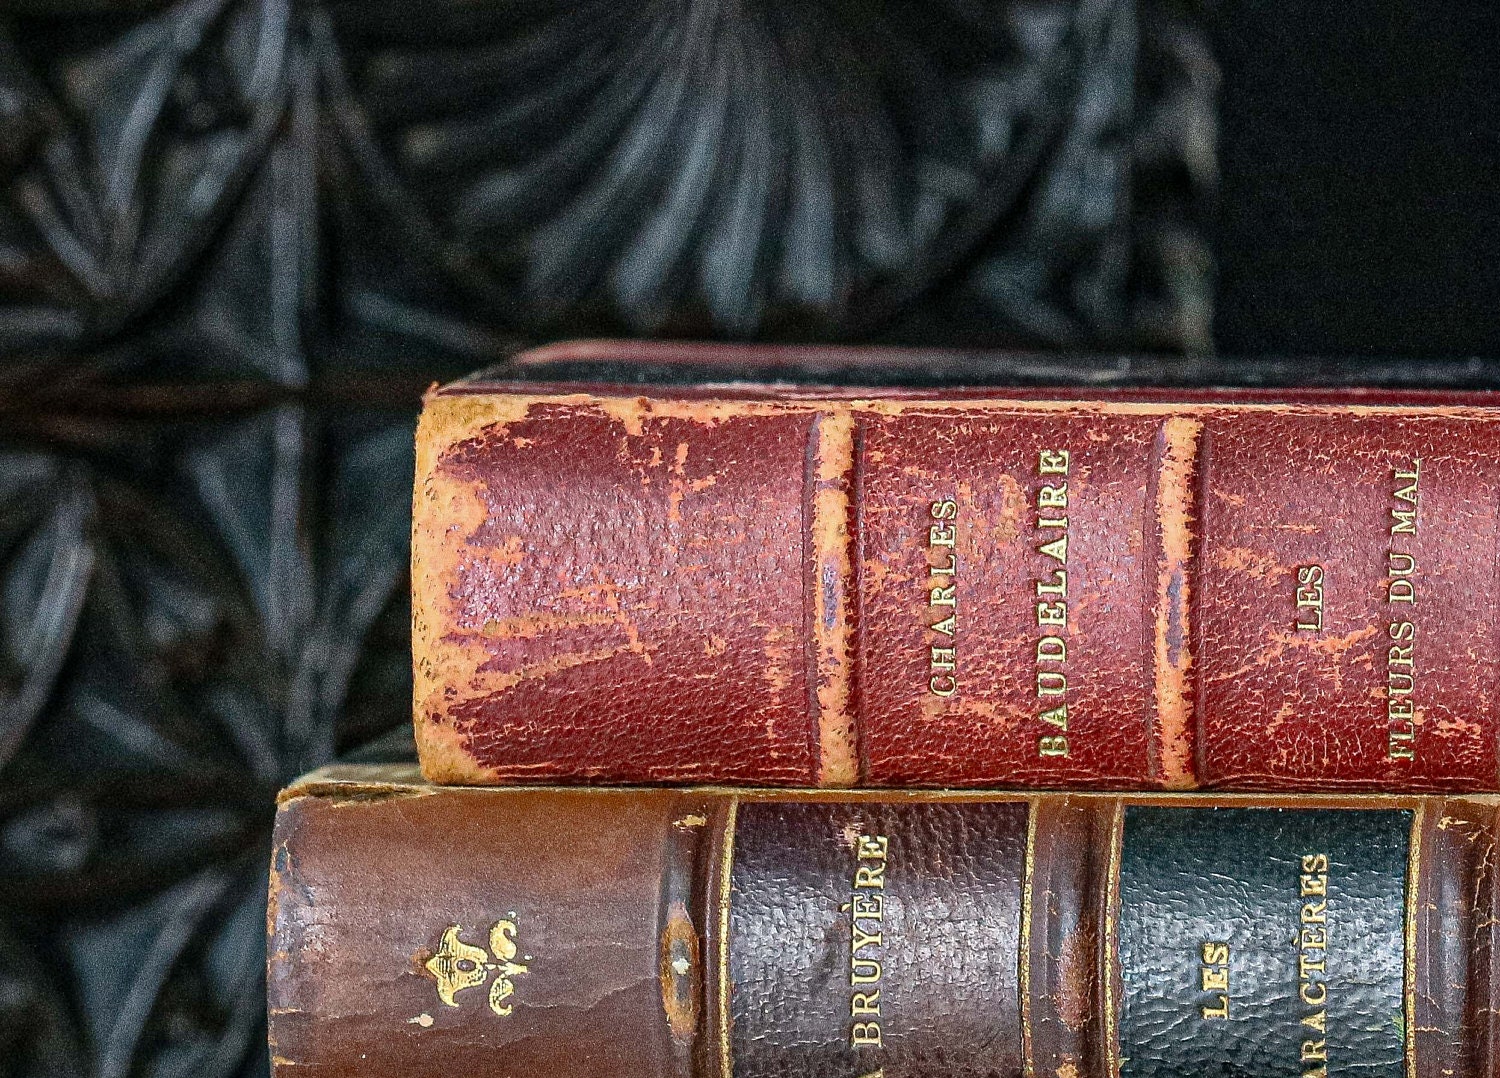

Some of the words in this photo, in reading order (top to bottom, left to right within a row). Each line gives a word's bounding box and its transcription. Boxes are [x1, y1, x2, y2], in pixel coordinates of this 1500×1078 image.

[1392, 459, 1421, 535] MAL
[930, 498, 958, 697] CHARLES
[1036, 450, 1070, 758] BAUDELAIRE
[1297, 565, 1324, 631] LES
[1389, 553, 1416, 605] DU
[1388, 621, 1415, 762] FLEURS
[841, 835, 889, 1048] BRUYÈRE
[1201, 942, 1230, 1021] LES
